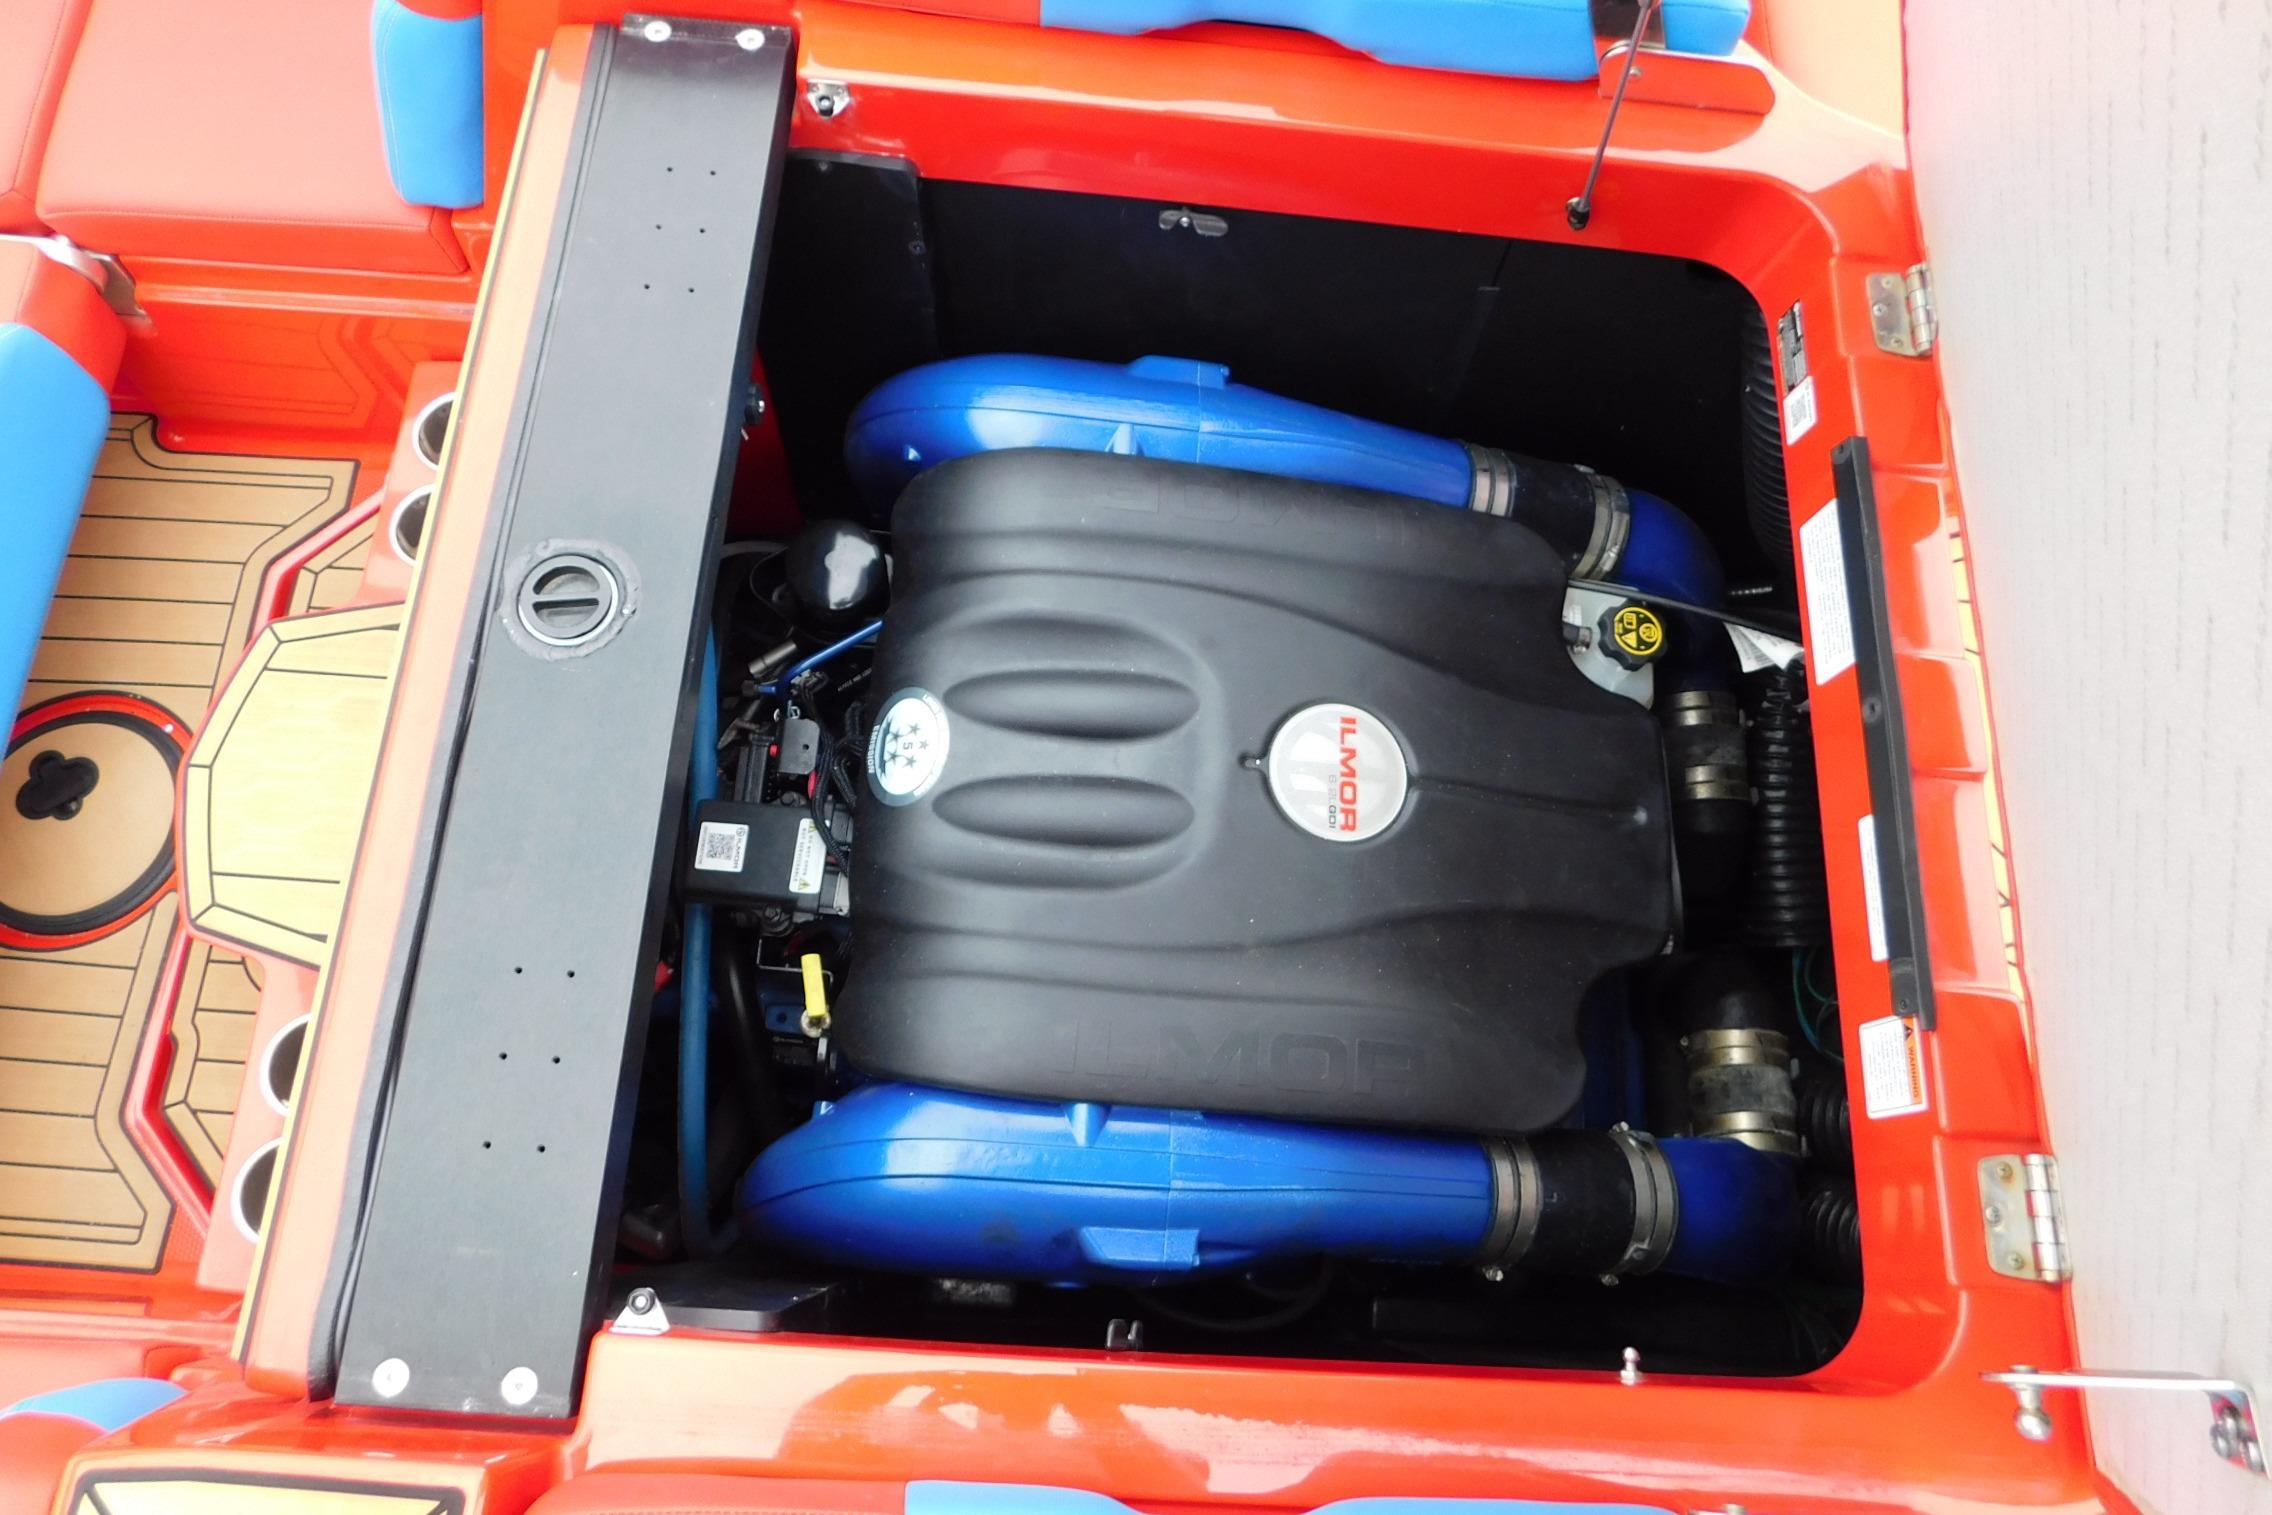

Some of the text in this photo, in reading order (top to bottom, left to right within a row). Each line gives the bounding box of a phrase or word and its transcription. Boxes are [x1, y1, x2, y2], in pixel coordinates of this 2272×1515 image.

[902, 741, 913, 751] 5
[1339, 716, 1358, 832] ILMOR
[1909, 1047, 1919, 1098] WARNING
